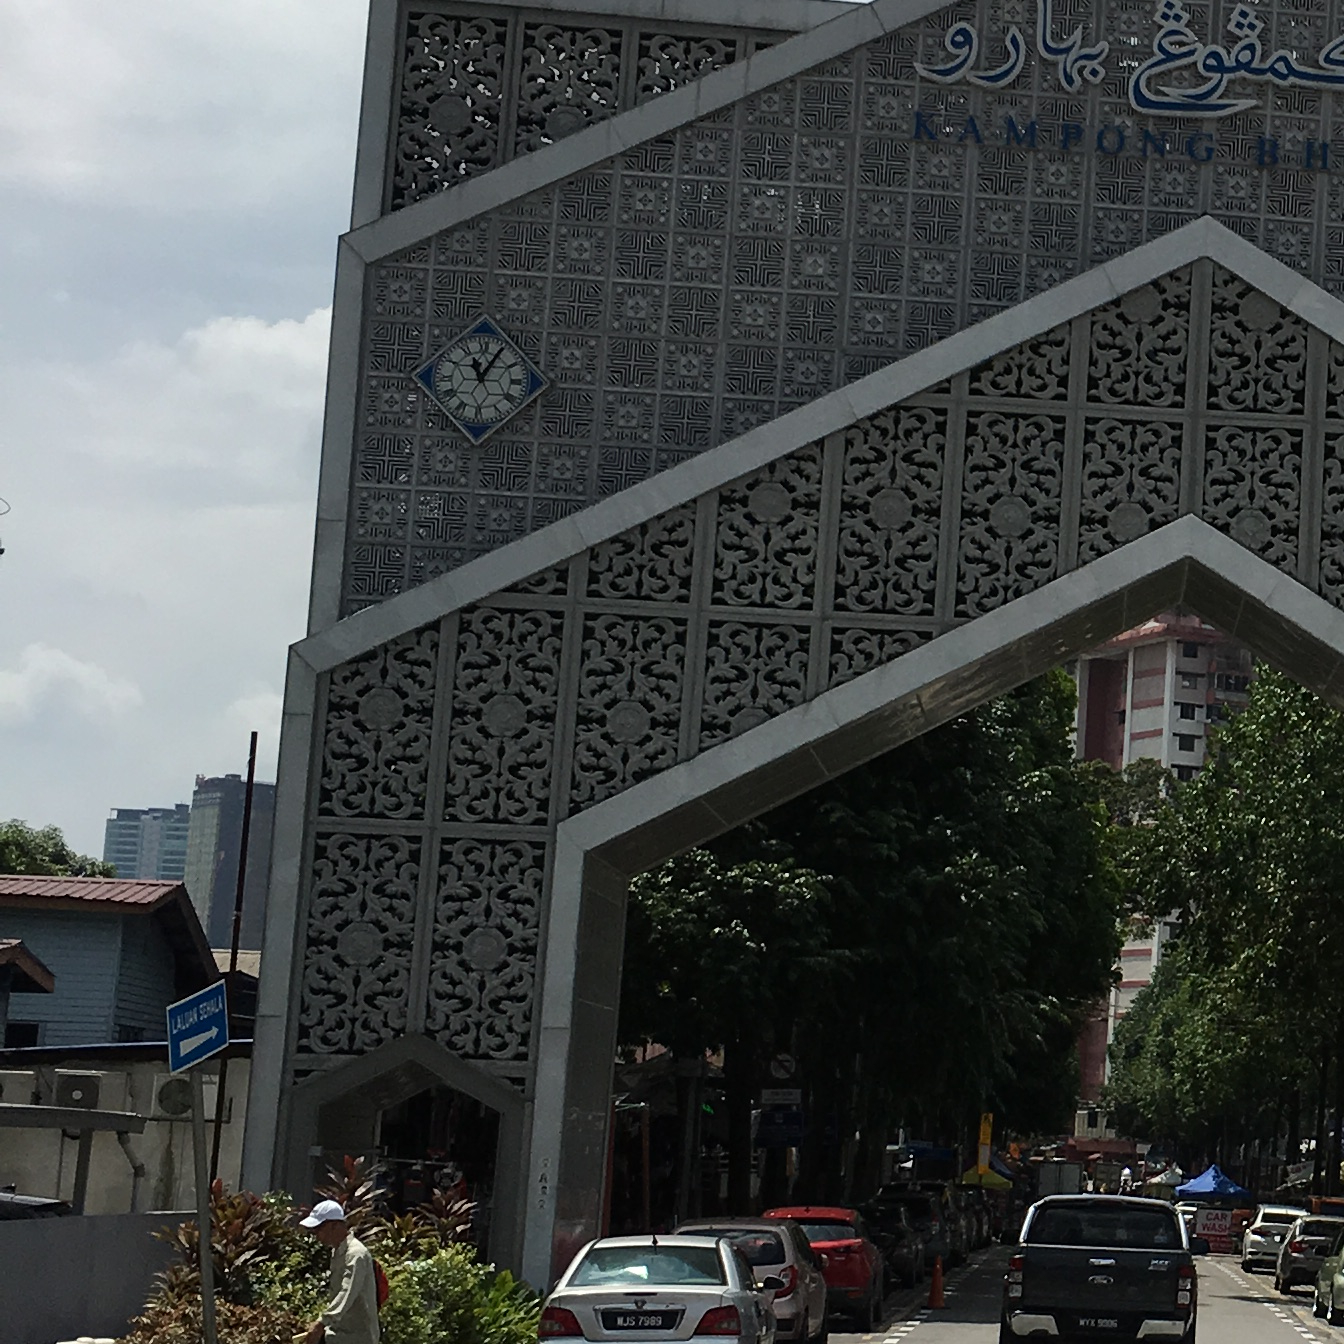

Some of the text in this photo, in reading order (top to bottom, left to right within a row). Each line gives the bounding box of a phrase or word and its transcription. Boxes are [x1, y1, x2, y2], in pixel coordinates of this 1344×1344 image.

[912, 108, 1216, 164] KAMPONG
[172, 995, 223, 1035] LALUAN SEHALA
[1206, 1212, 1228, 1221] CAR
[616, 1316, 663, 1327] WJS 7989
